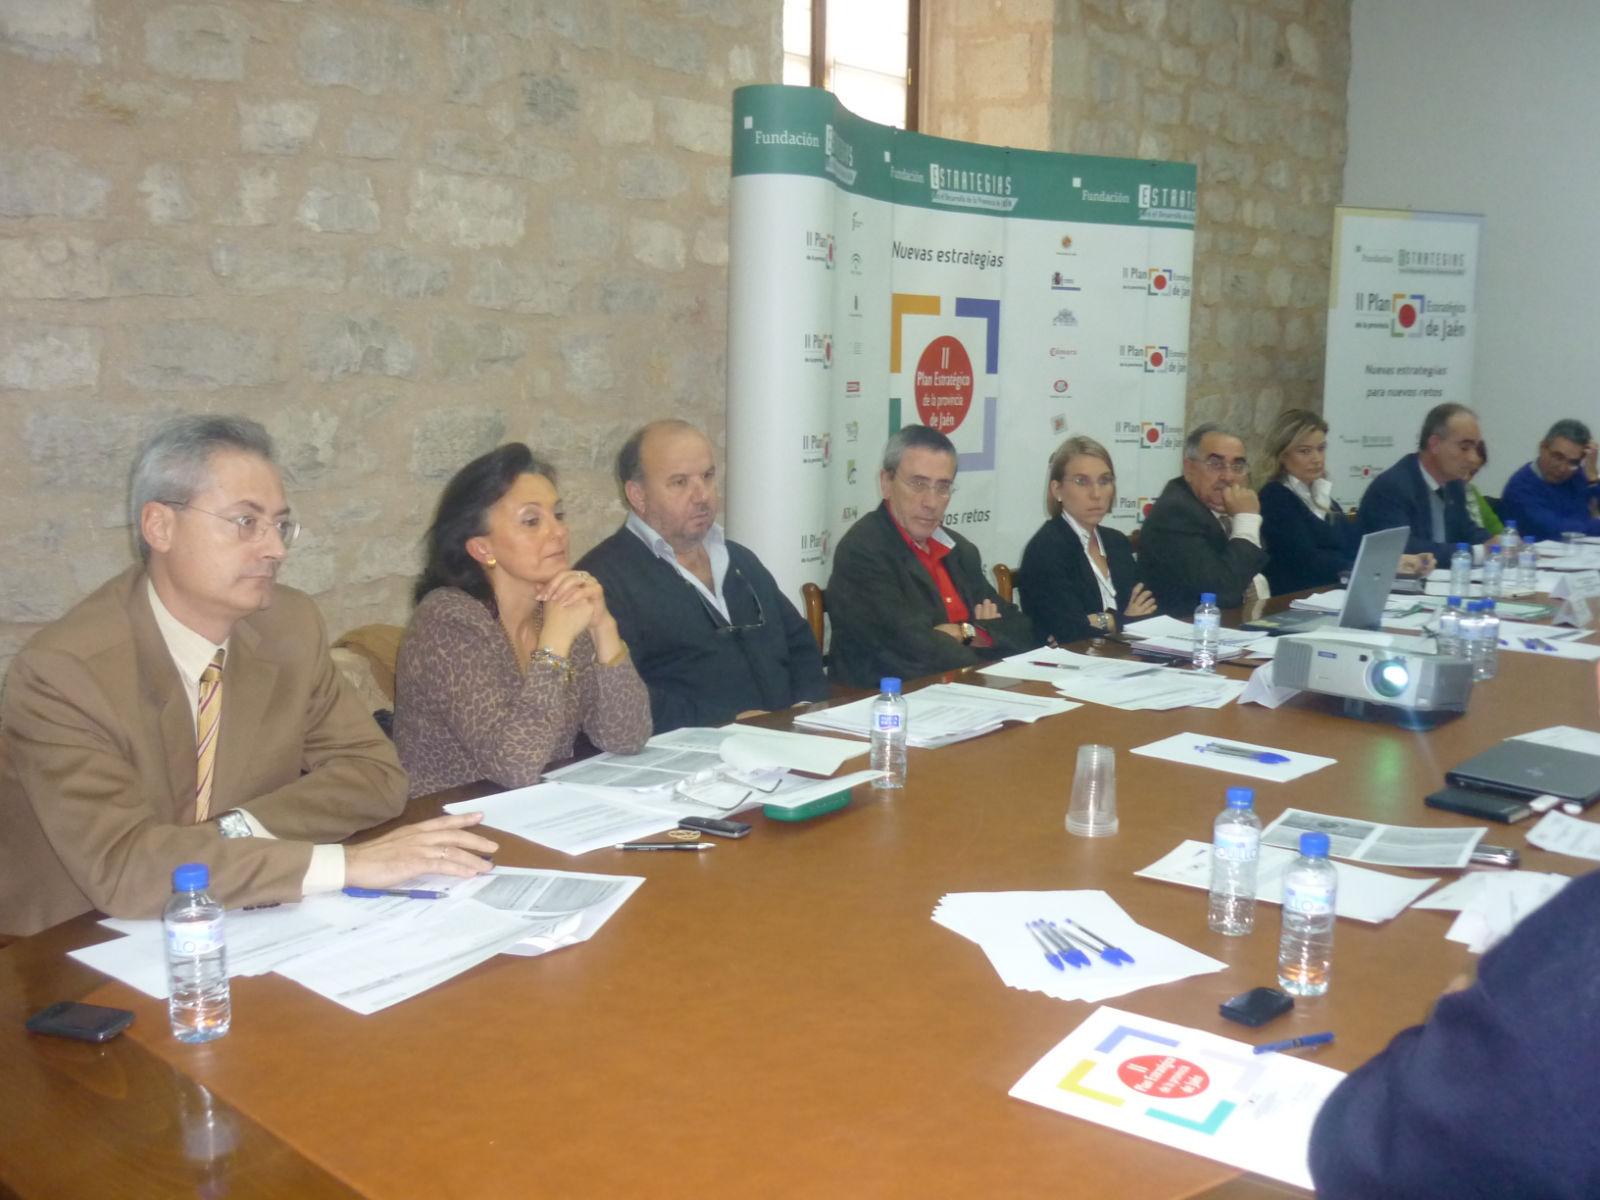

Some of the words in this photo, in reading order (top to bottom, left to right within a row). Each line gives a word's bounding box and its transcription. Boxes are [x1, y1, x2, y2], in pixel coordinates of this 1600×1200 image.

[754, 130, 820, 148] Fundación
[929, 163, 1013, 196] ESTRATEGIAS
[1082, 189, 1131, 204] Fundación
[892, 240, 934, 262] Nuevas
[936, 248, 1005, 270] estrategias
[1131, 267, 1147, 280] Plan
[1356, 293, 1364, 311] II
[1368, 293, 1391, 311] Plan
[1425, 319, 1439, 337] de
[941, 347, 950, 369] II
[1127, 345, 1144, 357] Plan
[917, 371, 932, 386] Plan
[934, 371, 970, 390] Estratégico
[929, 412, 938, 427] de
[1123, 421, 1140, 433] Plan
[1120, 497, 1137, 508] Plan
[960, 509, 991, 525] retos
